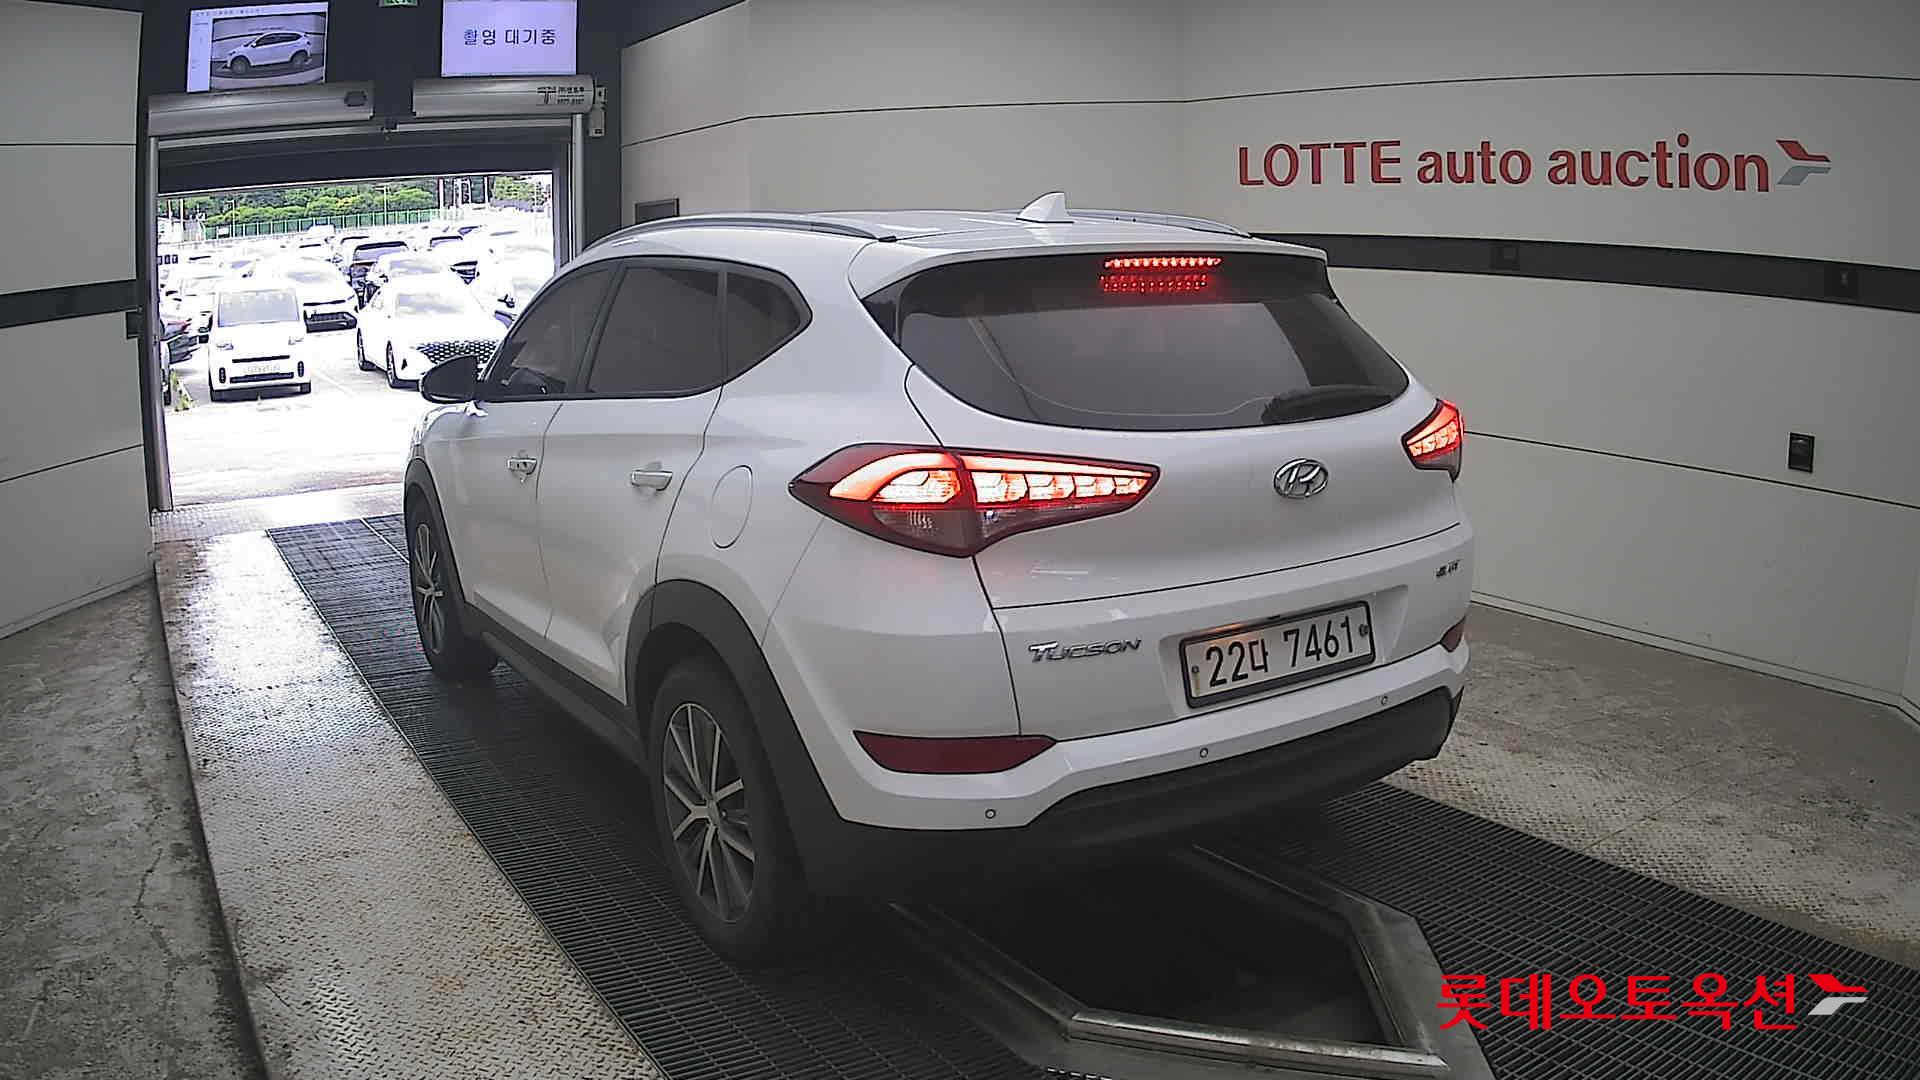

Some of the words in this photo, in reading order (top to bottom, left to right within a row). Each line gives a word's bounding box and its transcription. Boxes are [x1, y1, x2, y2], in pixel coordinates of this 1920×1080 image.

[504, 29, 556, 45] 대기중
[1239, 140, 1401, 187] LOTTE
[1417, 141, 1532, 184] auto
[1549, 133, 1769, 192] auction
[1029, 640, 1142, 662] TUCSON
[1205, 638, 1269, 687] 22다
[1283, 615, 1353, 668] 7461
